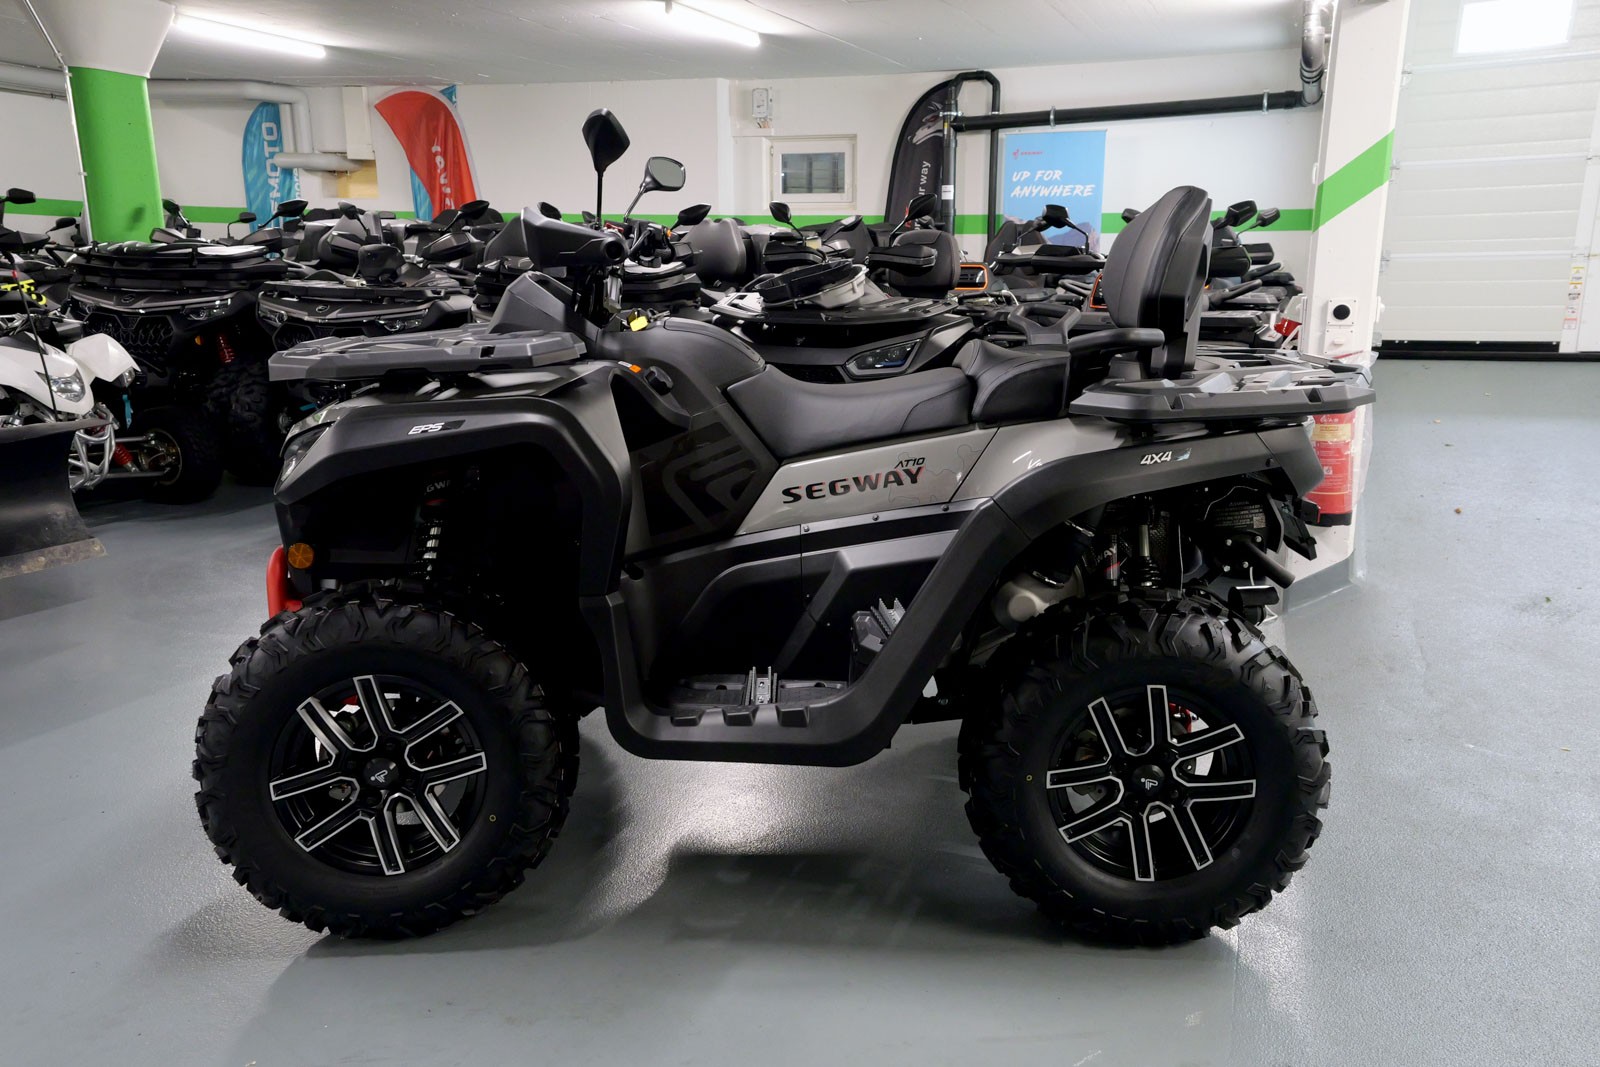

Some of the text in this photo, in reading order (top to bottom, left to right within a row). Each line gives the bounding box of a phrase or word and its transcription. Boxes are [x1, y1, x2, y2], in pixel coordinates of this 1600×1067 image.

[919, 160, 931, 185] way
[1012, 169, 1063, 182] UP FOR
[1010, 184, 1095, 198] ANYWHERE
[408, 422, 445, 435] EPS
[894, 457, 926, 469] AT10
[781, 465, 926, 504] SEGWAY
